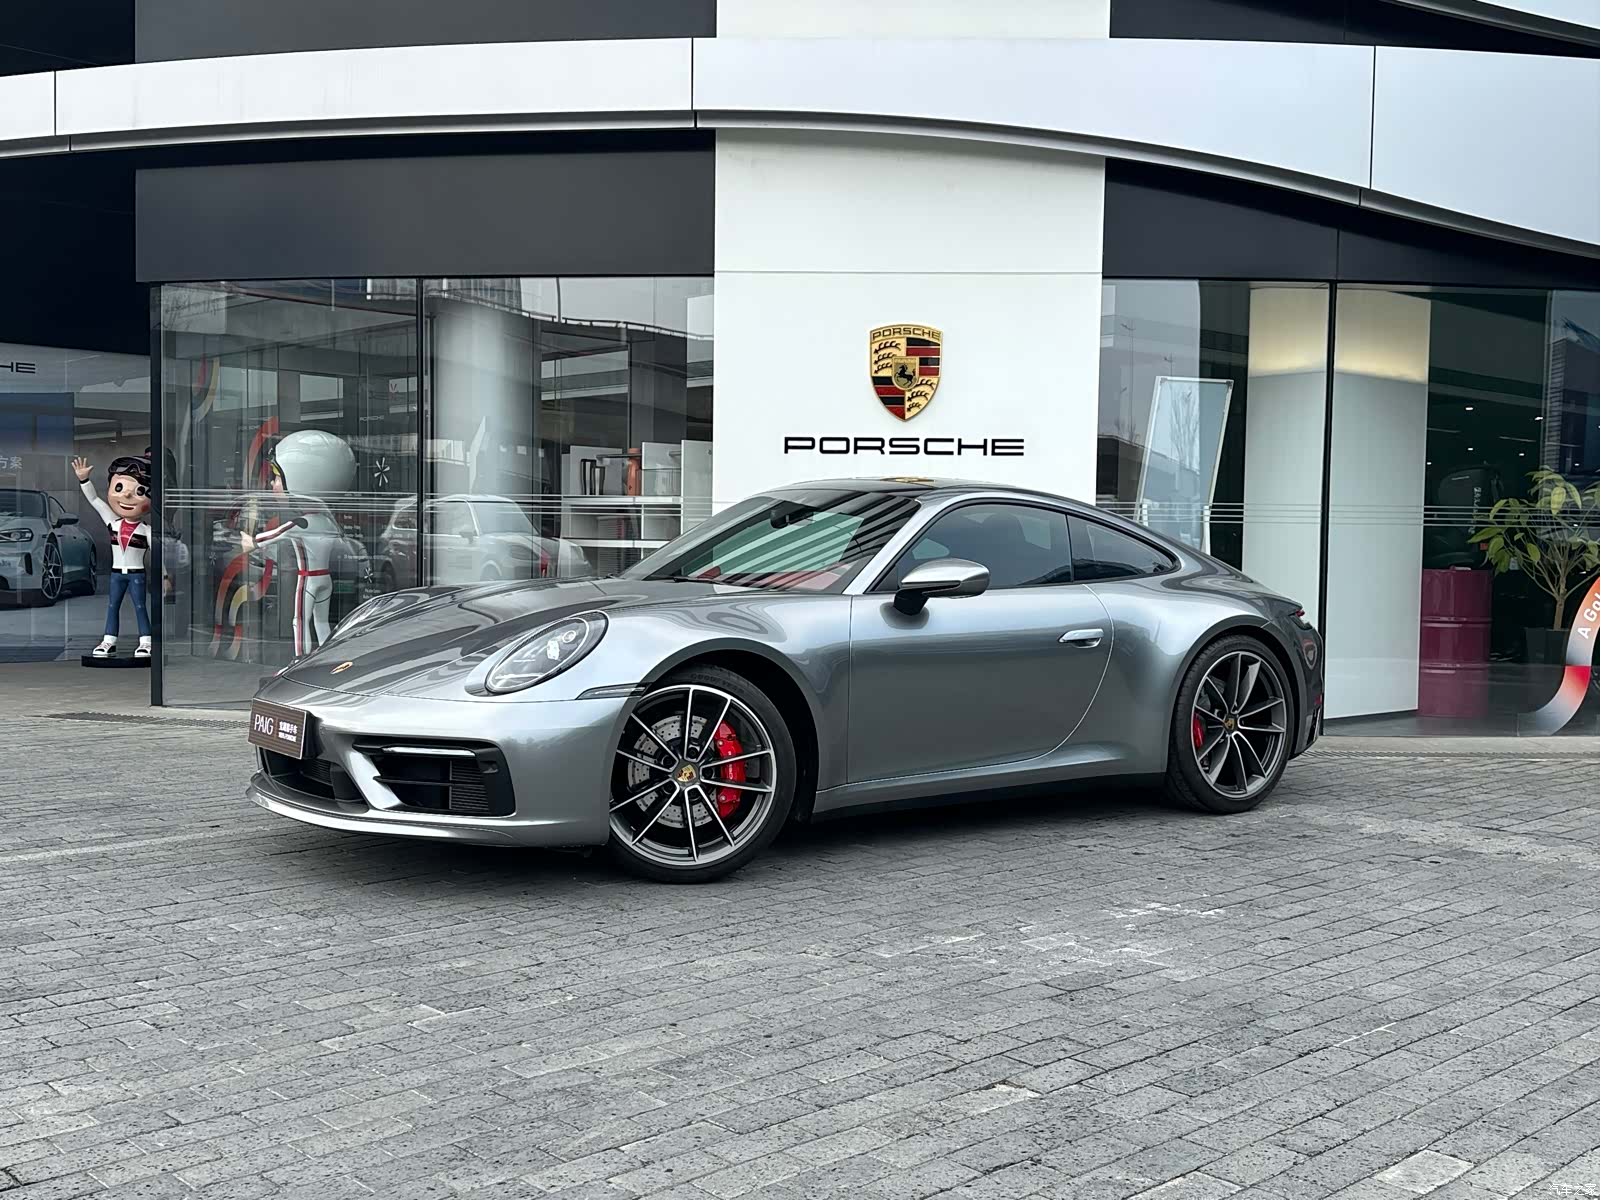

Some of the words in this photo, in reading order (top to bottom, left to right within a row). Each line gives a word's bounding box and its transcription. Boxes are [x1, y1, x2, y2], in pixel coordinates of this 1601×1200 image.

[872, 327, 941, 340] PORSCHE
[784, 436, 1025, 456] PORSCHE
[1577, 627, 1592, 639] A
[253, 713, 274, 735] PAIG
